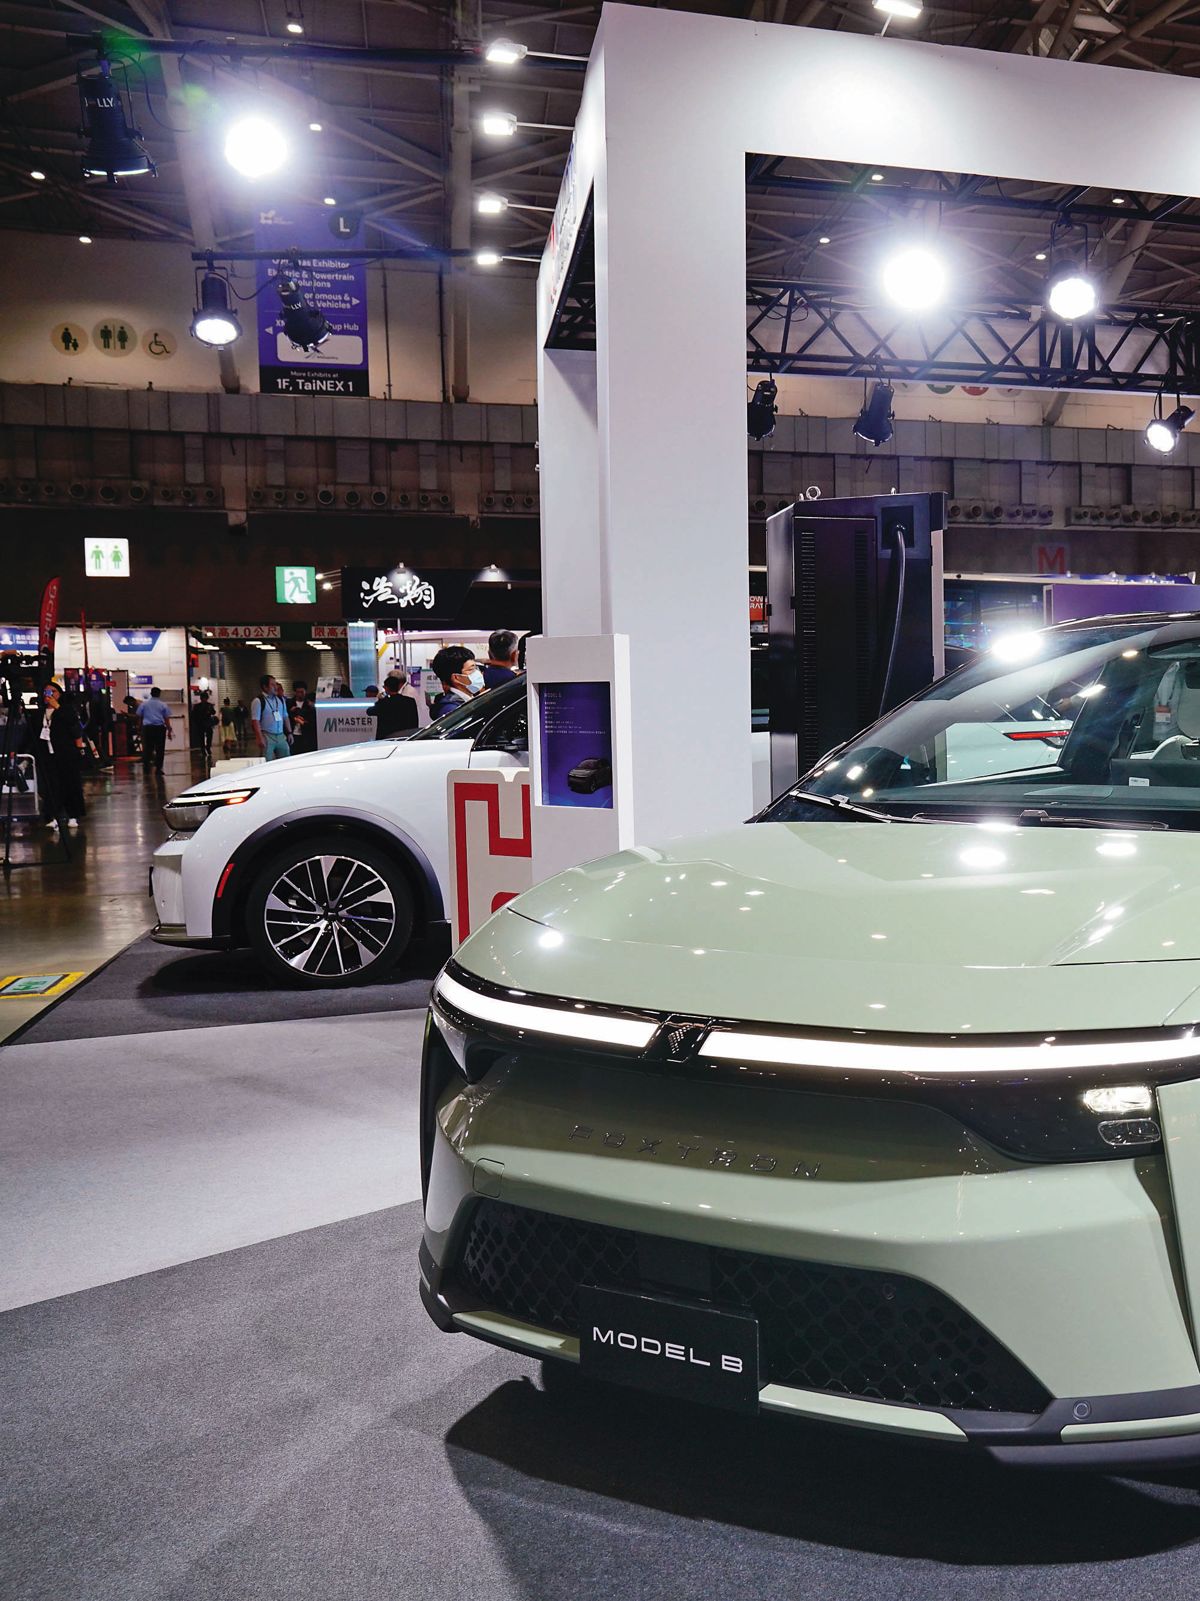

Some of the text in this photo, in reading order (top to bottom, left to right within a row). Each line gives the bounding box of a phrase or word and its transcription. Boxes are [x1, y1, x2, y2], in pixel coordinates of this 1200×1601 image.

[276, 378, 354, 392] 1F, TaiNEX 1
[338, 717, 373, 726] MASTER
[568, 1124, 821, 1180] FOXTRON
[592, 1326, 743, 1374] MODEL B
